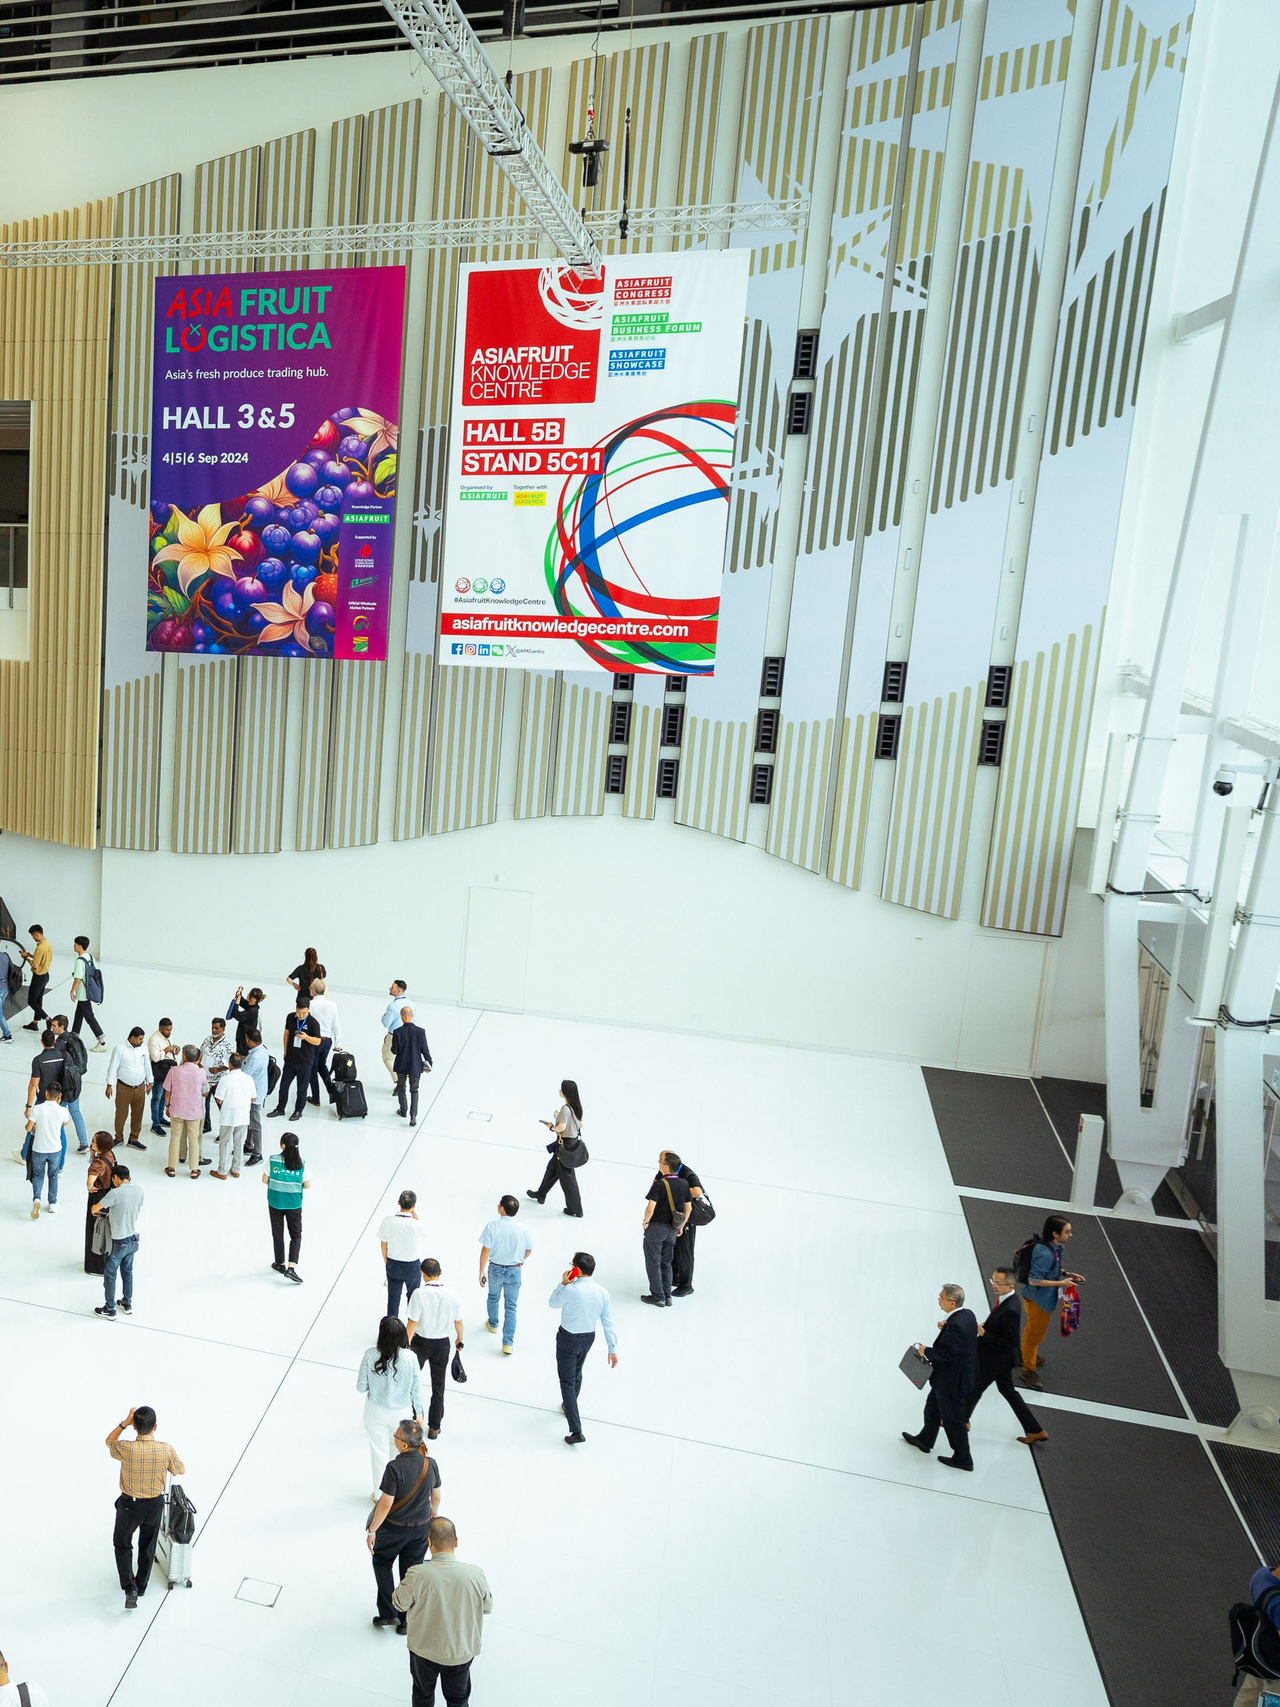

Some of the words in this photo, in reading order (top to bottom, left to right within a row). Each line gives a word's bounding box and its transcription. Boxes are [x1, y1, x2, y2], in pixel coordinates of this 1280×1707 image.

[616, 278, 671, 288] ASIAFRUIT
[166, 286, 233, 320] ASIA
[240, 286, 333, 317] FRUIT
[615, 289, 670, 299] CONGRESS
[613, 314, 668, 324] ASIAFRUIT
[165, 322, 333, 354] LOGISTICA
[612, 325, 662, 335] BUSINESS
[665, 323, 701, 333] FORUM
[471, 345, 573, 365] ASIAFRUIT
[610, 350, 665, 359] ASIAFRUIT
[165, 369, 194, 380] Asia's
[195, 368, 221, 380] fresh
[223, 369, 265, 382] produce
[267, 366, 304, 380] trading
[306, 367, 329, 378] hub.
[470, 362, 591, 383] KNOWLEDGE
[610, 360, 664, 370] SHOWCASE
[470, 380, 543, 400] CENTRE
[162, 406, 231, 430] HALL
[466, 424, 527, 443] HALL
[531, 422, 561, 442] 5B
[197, 452, 219, 467] Sep
[221, 452, 249, 464] 2024
[464, 453, 542, 473] STAND
[547, 452, 601, 472] 5C11
[454, 596, 546, 606] #AsiafruitKnowledgeCentre
[452, 616, 689, 638] asiafruitknowledgecentre.com
